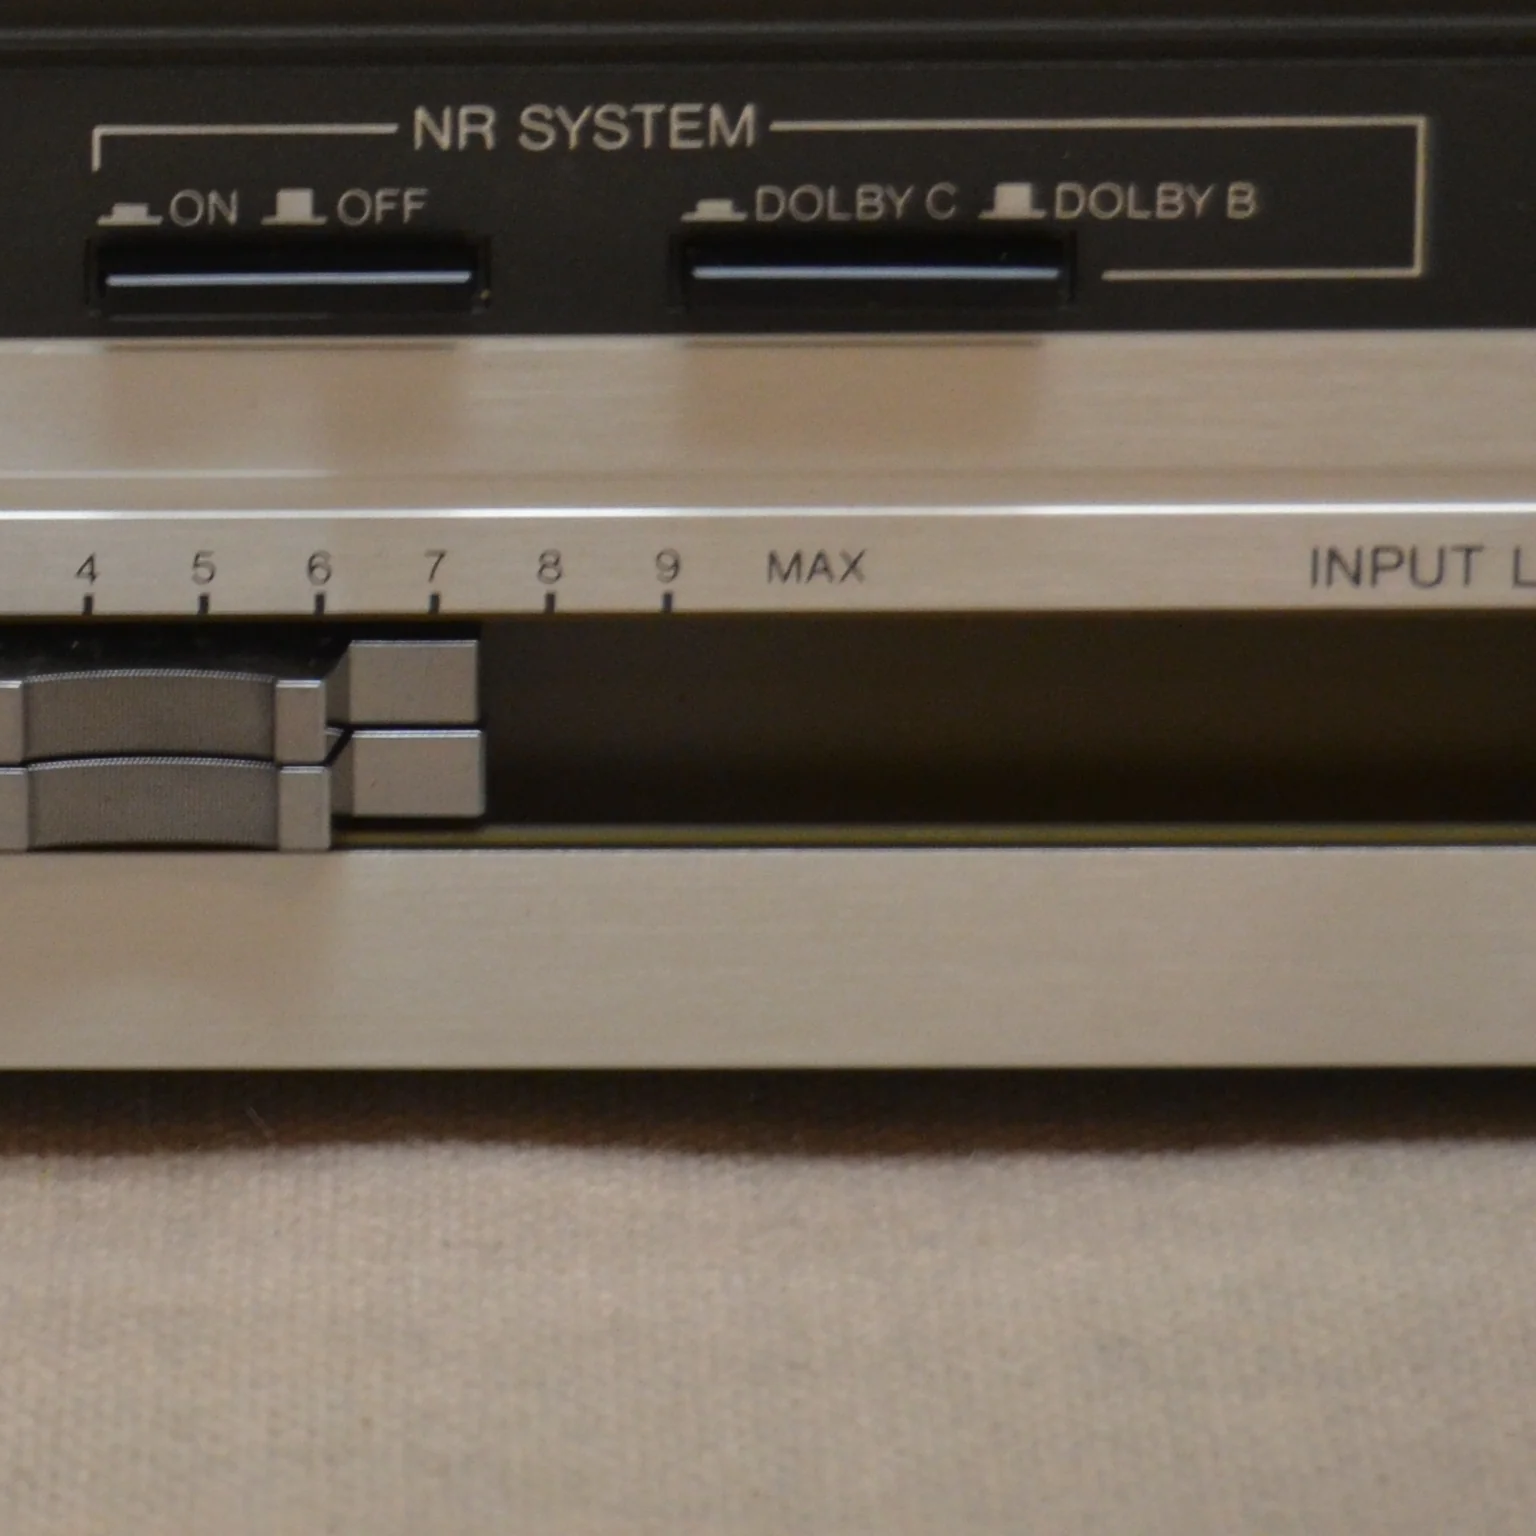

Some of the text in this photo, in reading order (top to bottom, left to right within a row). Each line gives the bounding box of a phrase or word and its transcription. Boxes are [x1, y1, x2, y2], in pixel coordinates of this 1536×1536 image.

[412, 103, 757, 152] NR SYSTEM
[169, 188, 238, 227] ON
[336, 187, 428, 226] OFF
[755, 183, 958, 222] DOLBY C
[1054, 181, 1259, 220] DOLBY B
[75, 553, 100, 585] 4
[191, 551, 217, 584] 5
[306, 550, 333, 584] 6
[425, 550, 448, 583] 7
[537, 550, 563, 583] 8
[654, 549, 682, 583] 9
[766, 549, 867, 584] MAX
[1309, 545, 1485, 588] INPUT
